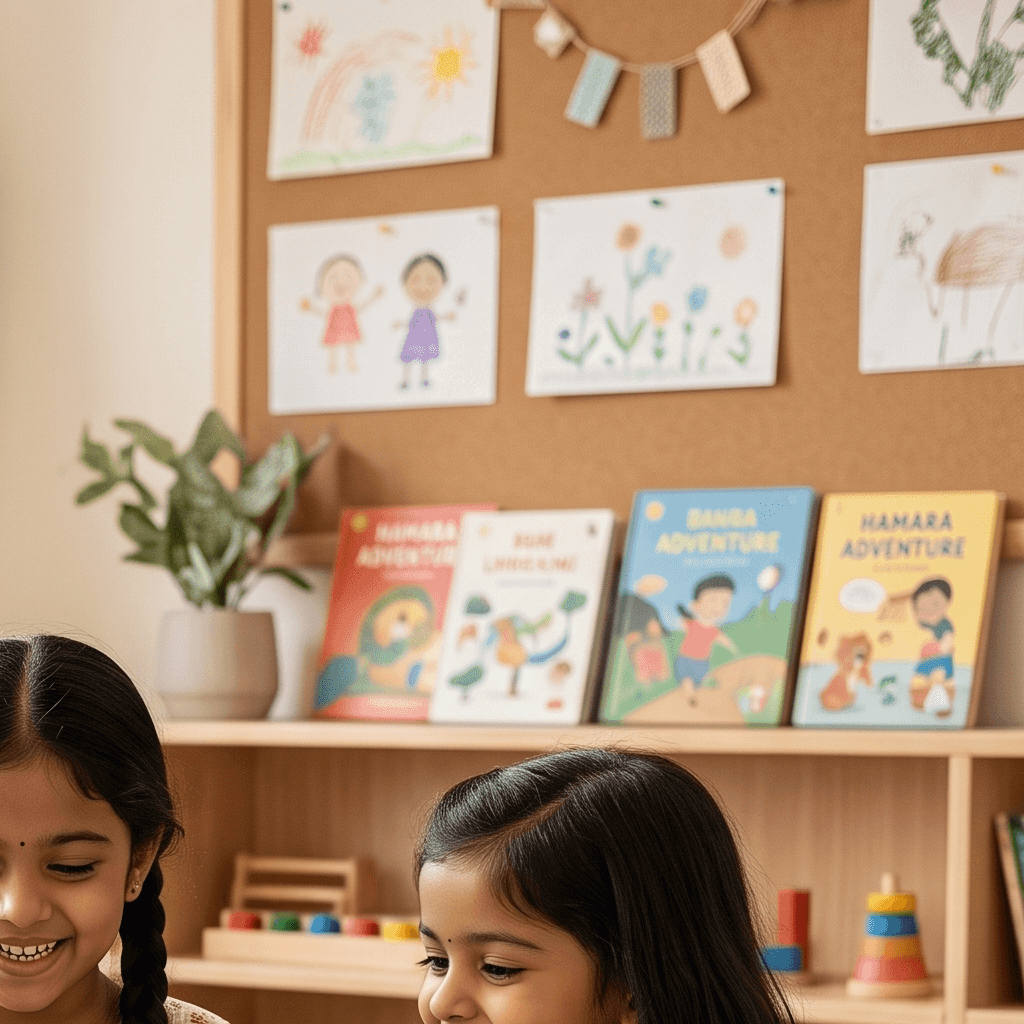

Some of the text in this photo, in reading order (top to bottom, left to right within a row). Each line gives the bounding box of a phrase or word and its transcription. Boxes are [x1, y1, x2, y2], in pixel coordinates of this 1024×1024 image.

[860, 512, 953, 532] HAMARA
[656, 531, 780, 554] ADVENTURE
[840, 537, 966, 560] ADVENTURE
